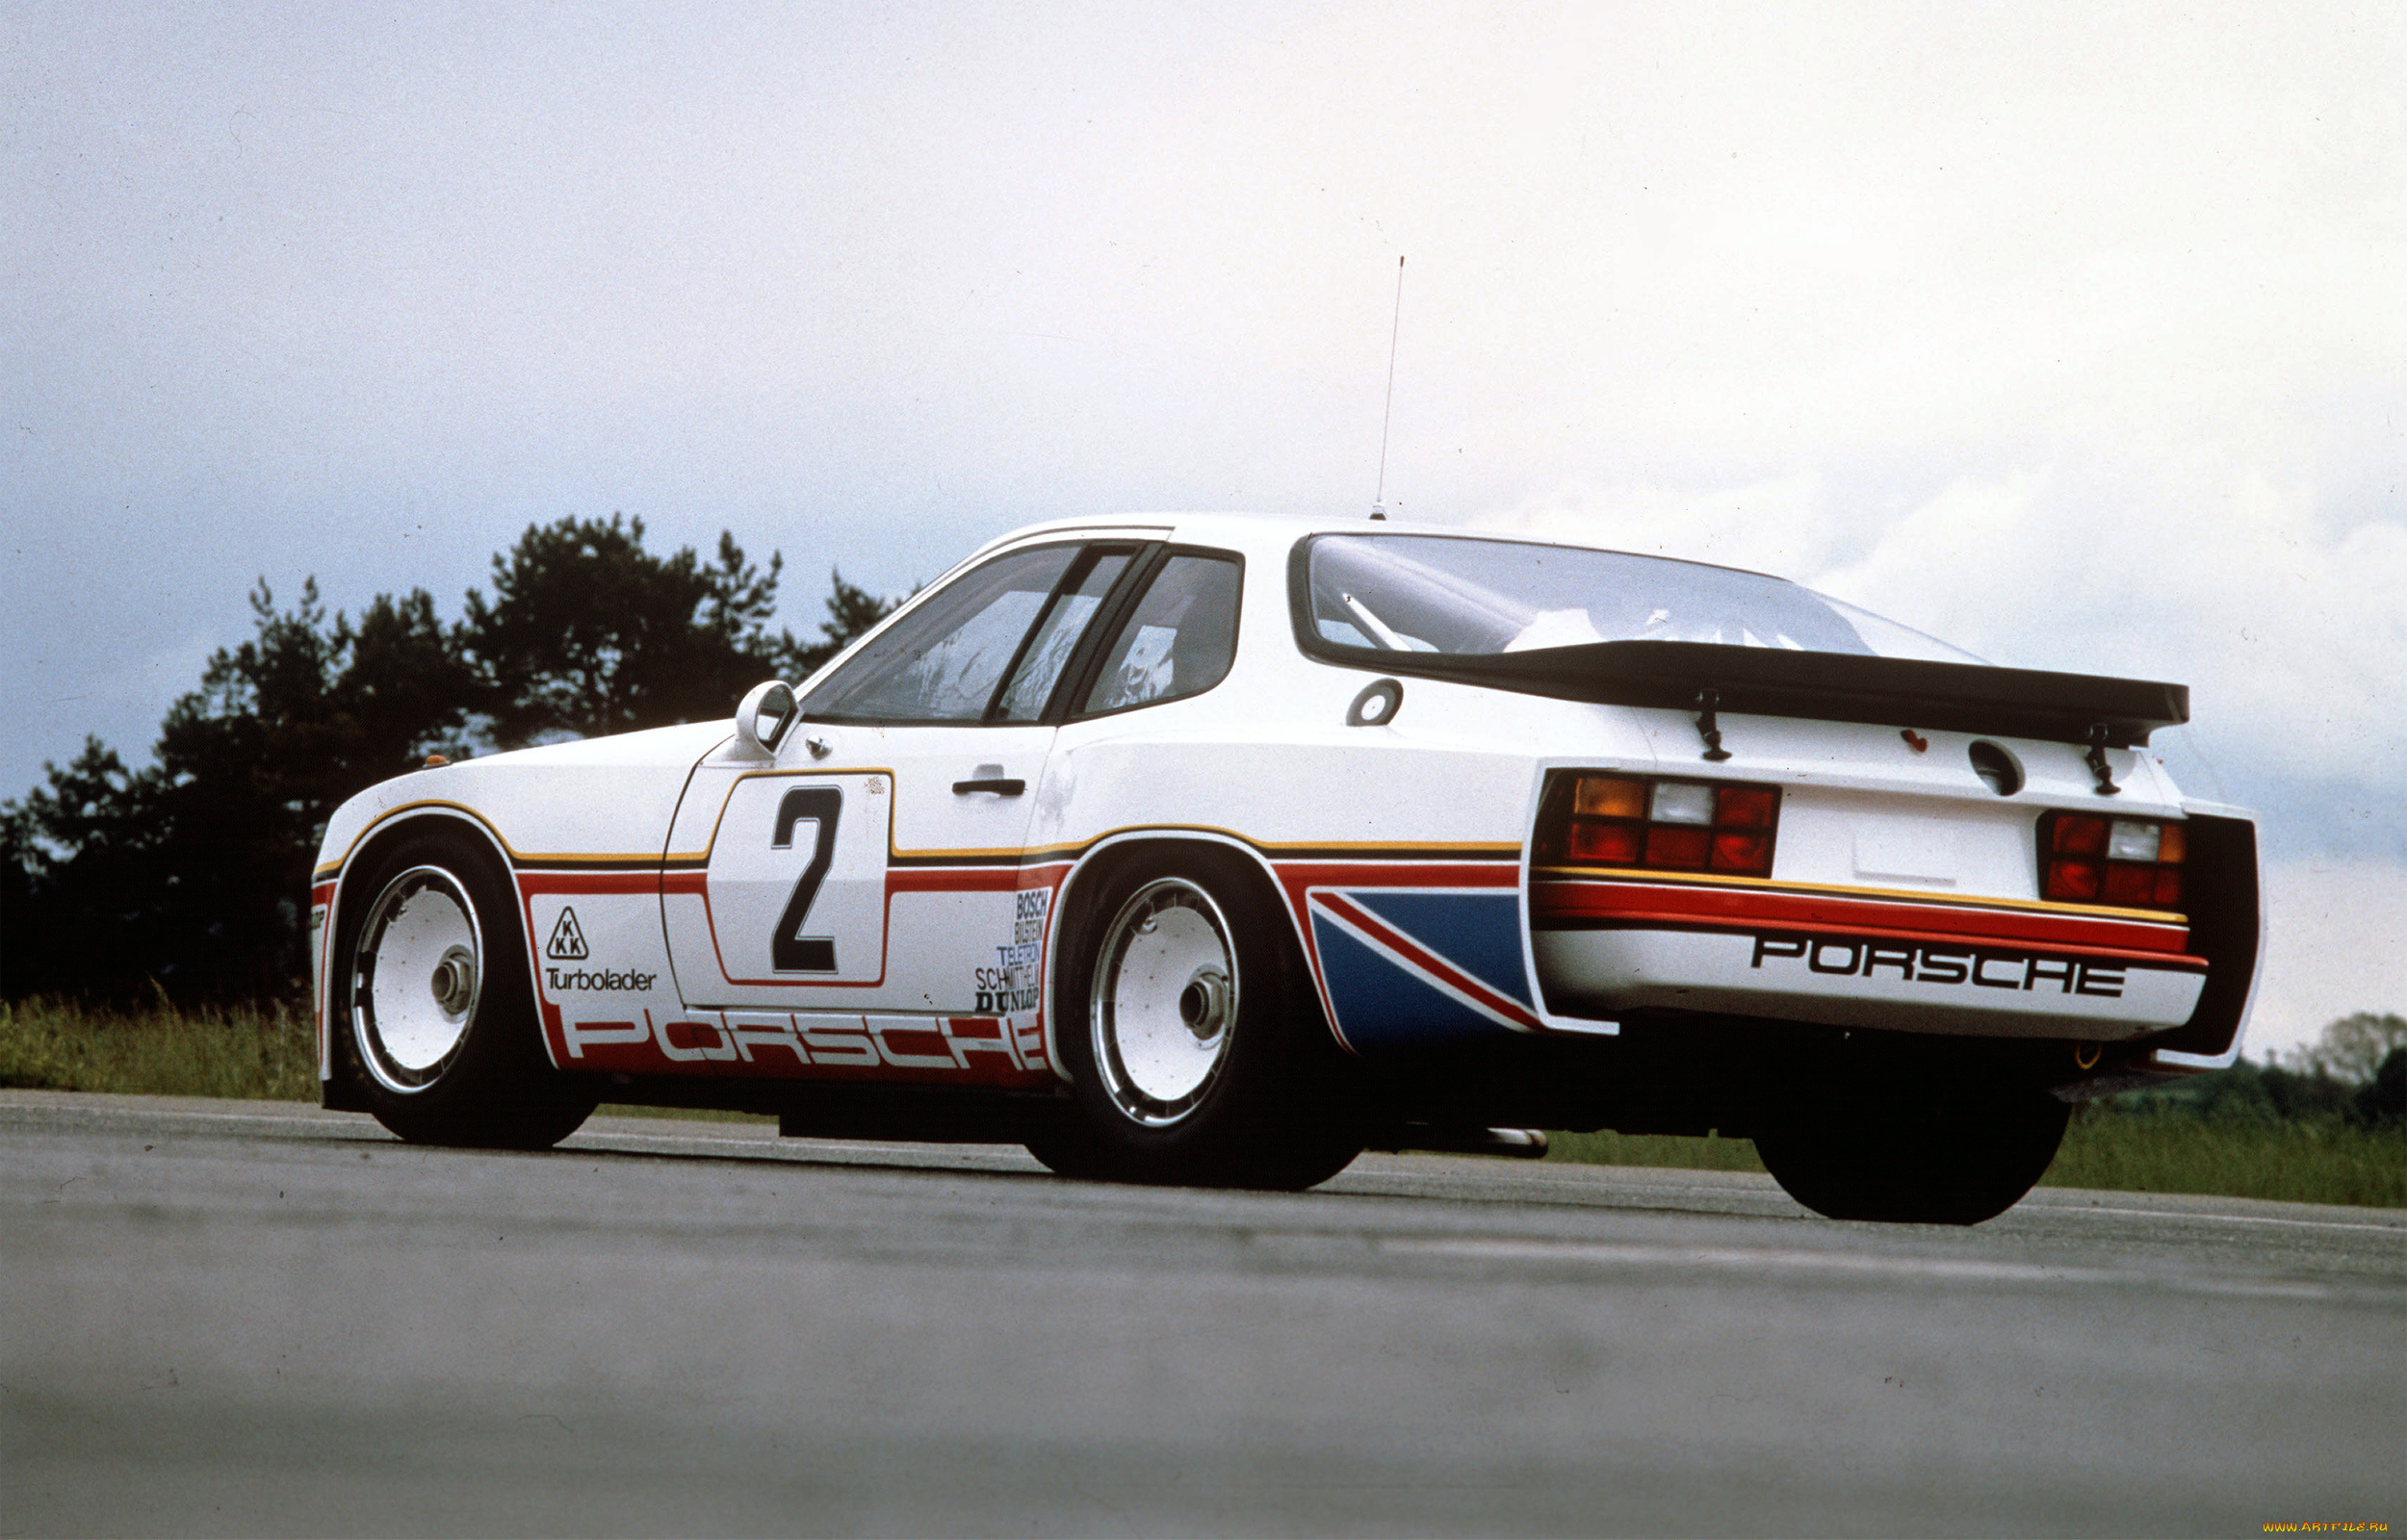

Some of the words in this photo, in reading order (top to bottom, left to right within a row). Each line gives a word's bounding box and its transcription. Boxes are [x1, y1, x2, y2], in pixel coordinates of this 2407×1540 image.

[771, 784, 844, 974] 2
[1016, 890, 1048, 920] BOSCH
[1014, 919, 1045, 944] BILSTEIN
[545, 967, 658, 991] Turbolader
[1751, 935, 2127, 998] PORSCHE
[974, 987, 1040, 1014] DUNLOP
[558, 1007, 1048, 1071] PORSCHE
